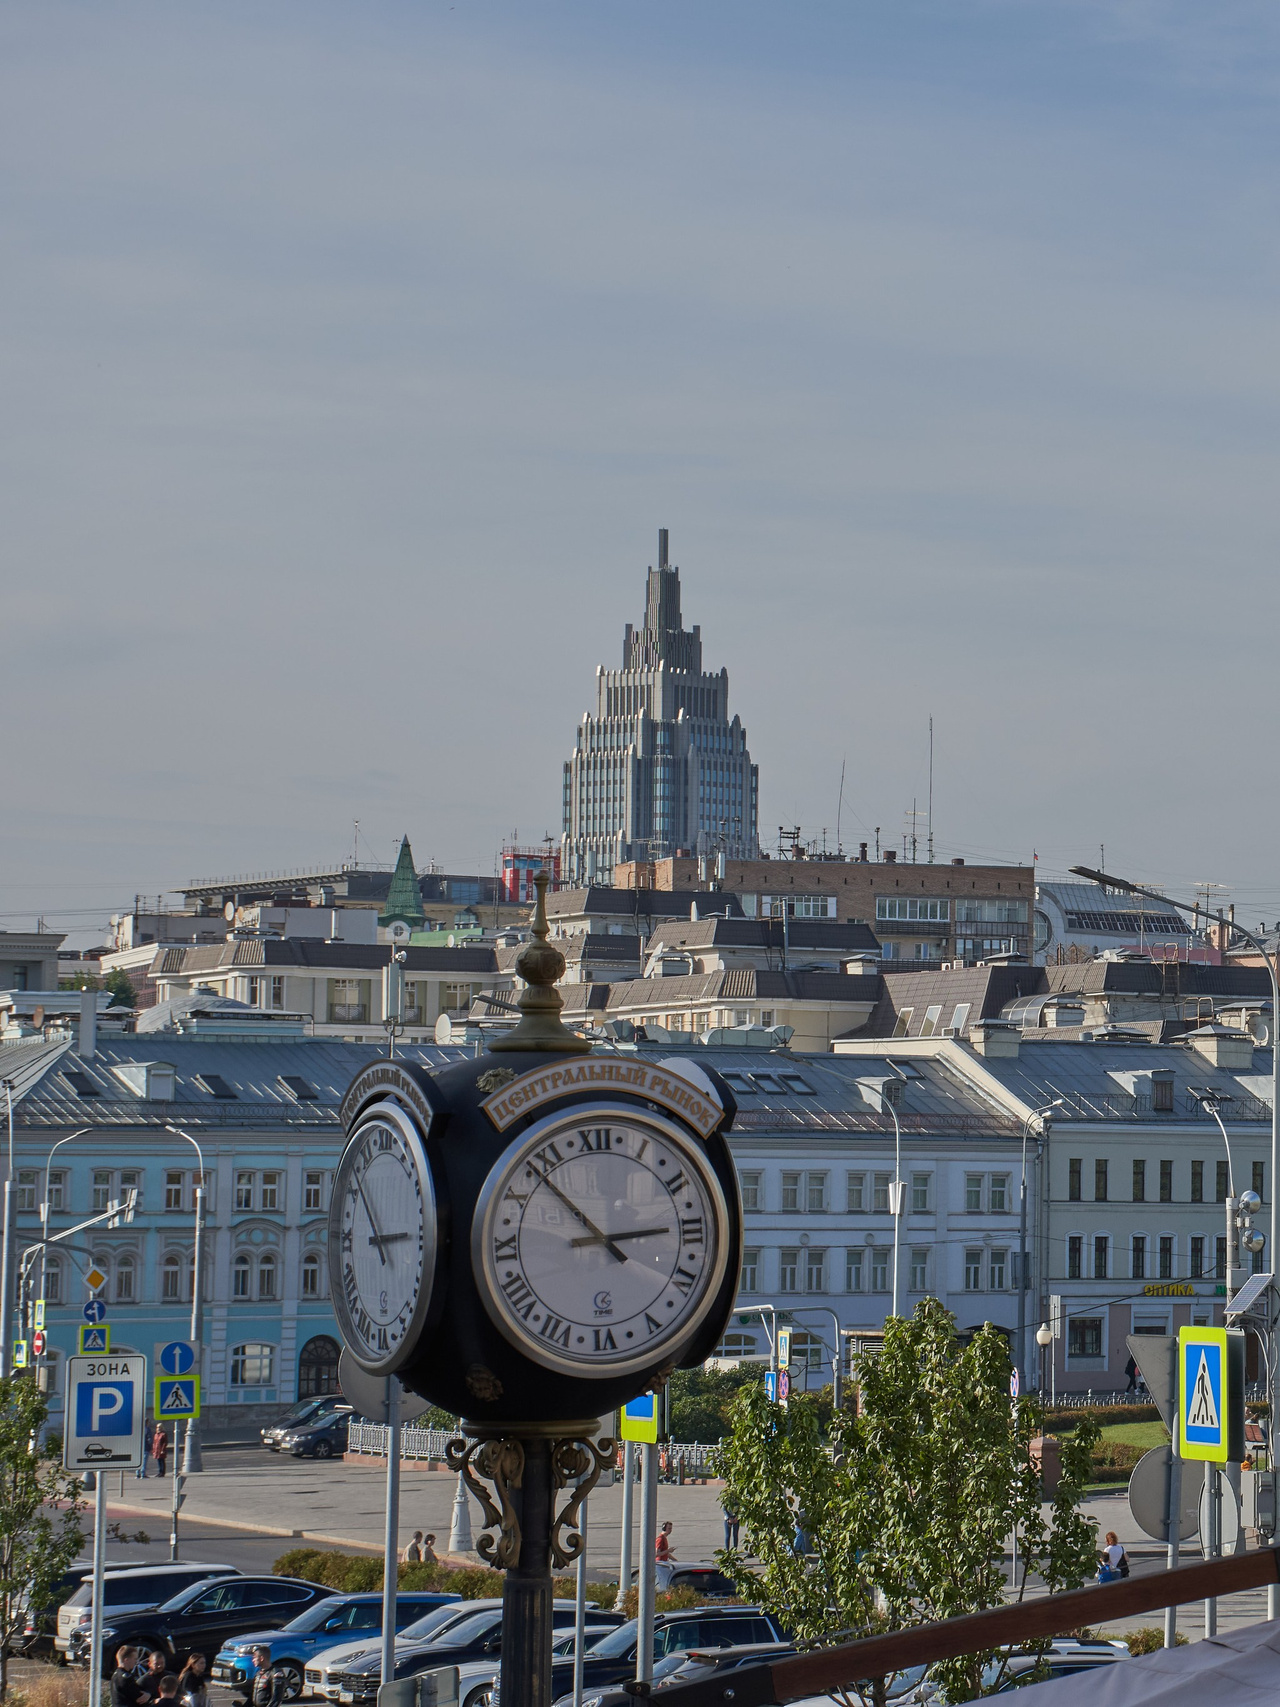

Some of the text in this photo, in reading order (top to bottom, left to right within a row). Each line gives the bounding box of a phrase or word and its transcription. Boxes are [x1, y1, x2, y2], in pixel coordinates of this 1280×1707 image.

[648, 1076, 715, 1128] РЫНОК
[577, 1128, 613, 1152] XII
[635, 1139, 650, 1161] I
[535, 1141, 564, 1173] XI
[664, 1169, 690, 1196] II
[505, 1186, 529, 1209] X
[681, 1216, 703, 1245] III
[494, 1234, 517, 1263] IX
[672, 1266, 697, 1297] IV
[1144, 1284, 1194, 1296] ОПТИКА
[501, 1273, 537, 1321] VIII
[539, 1313, 573, 1348] VII
[644, 1312, 663, 1335] V
[593, 1328, 619, 1352] VI
[87, 1363, 130, 1376] ЗОНА
